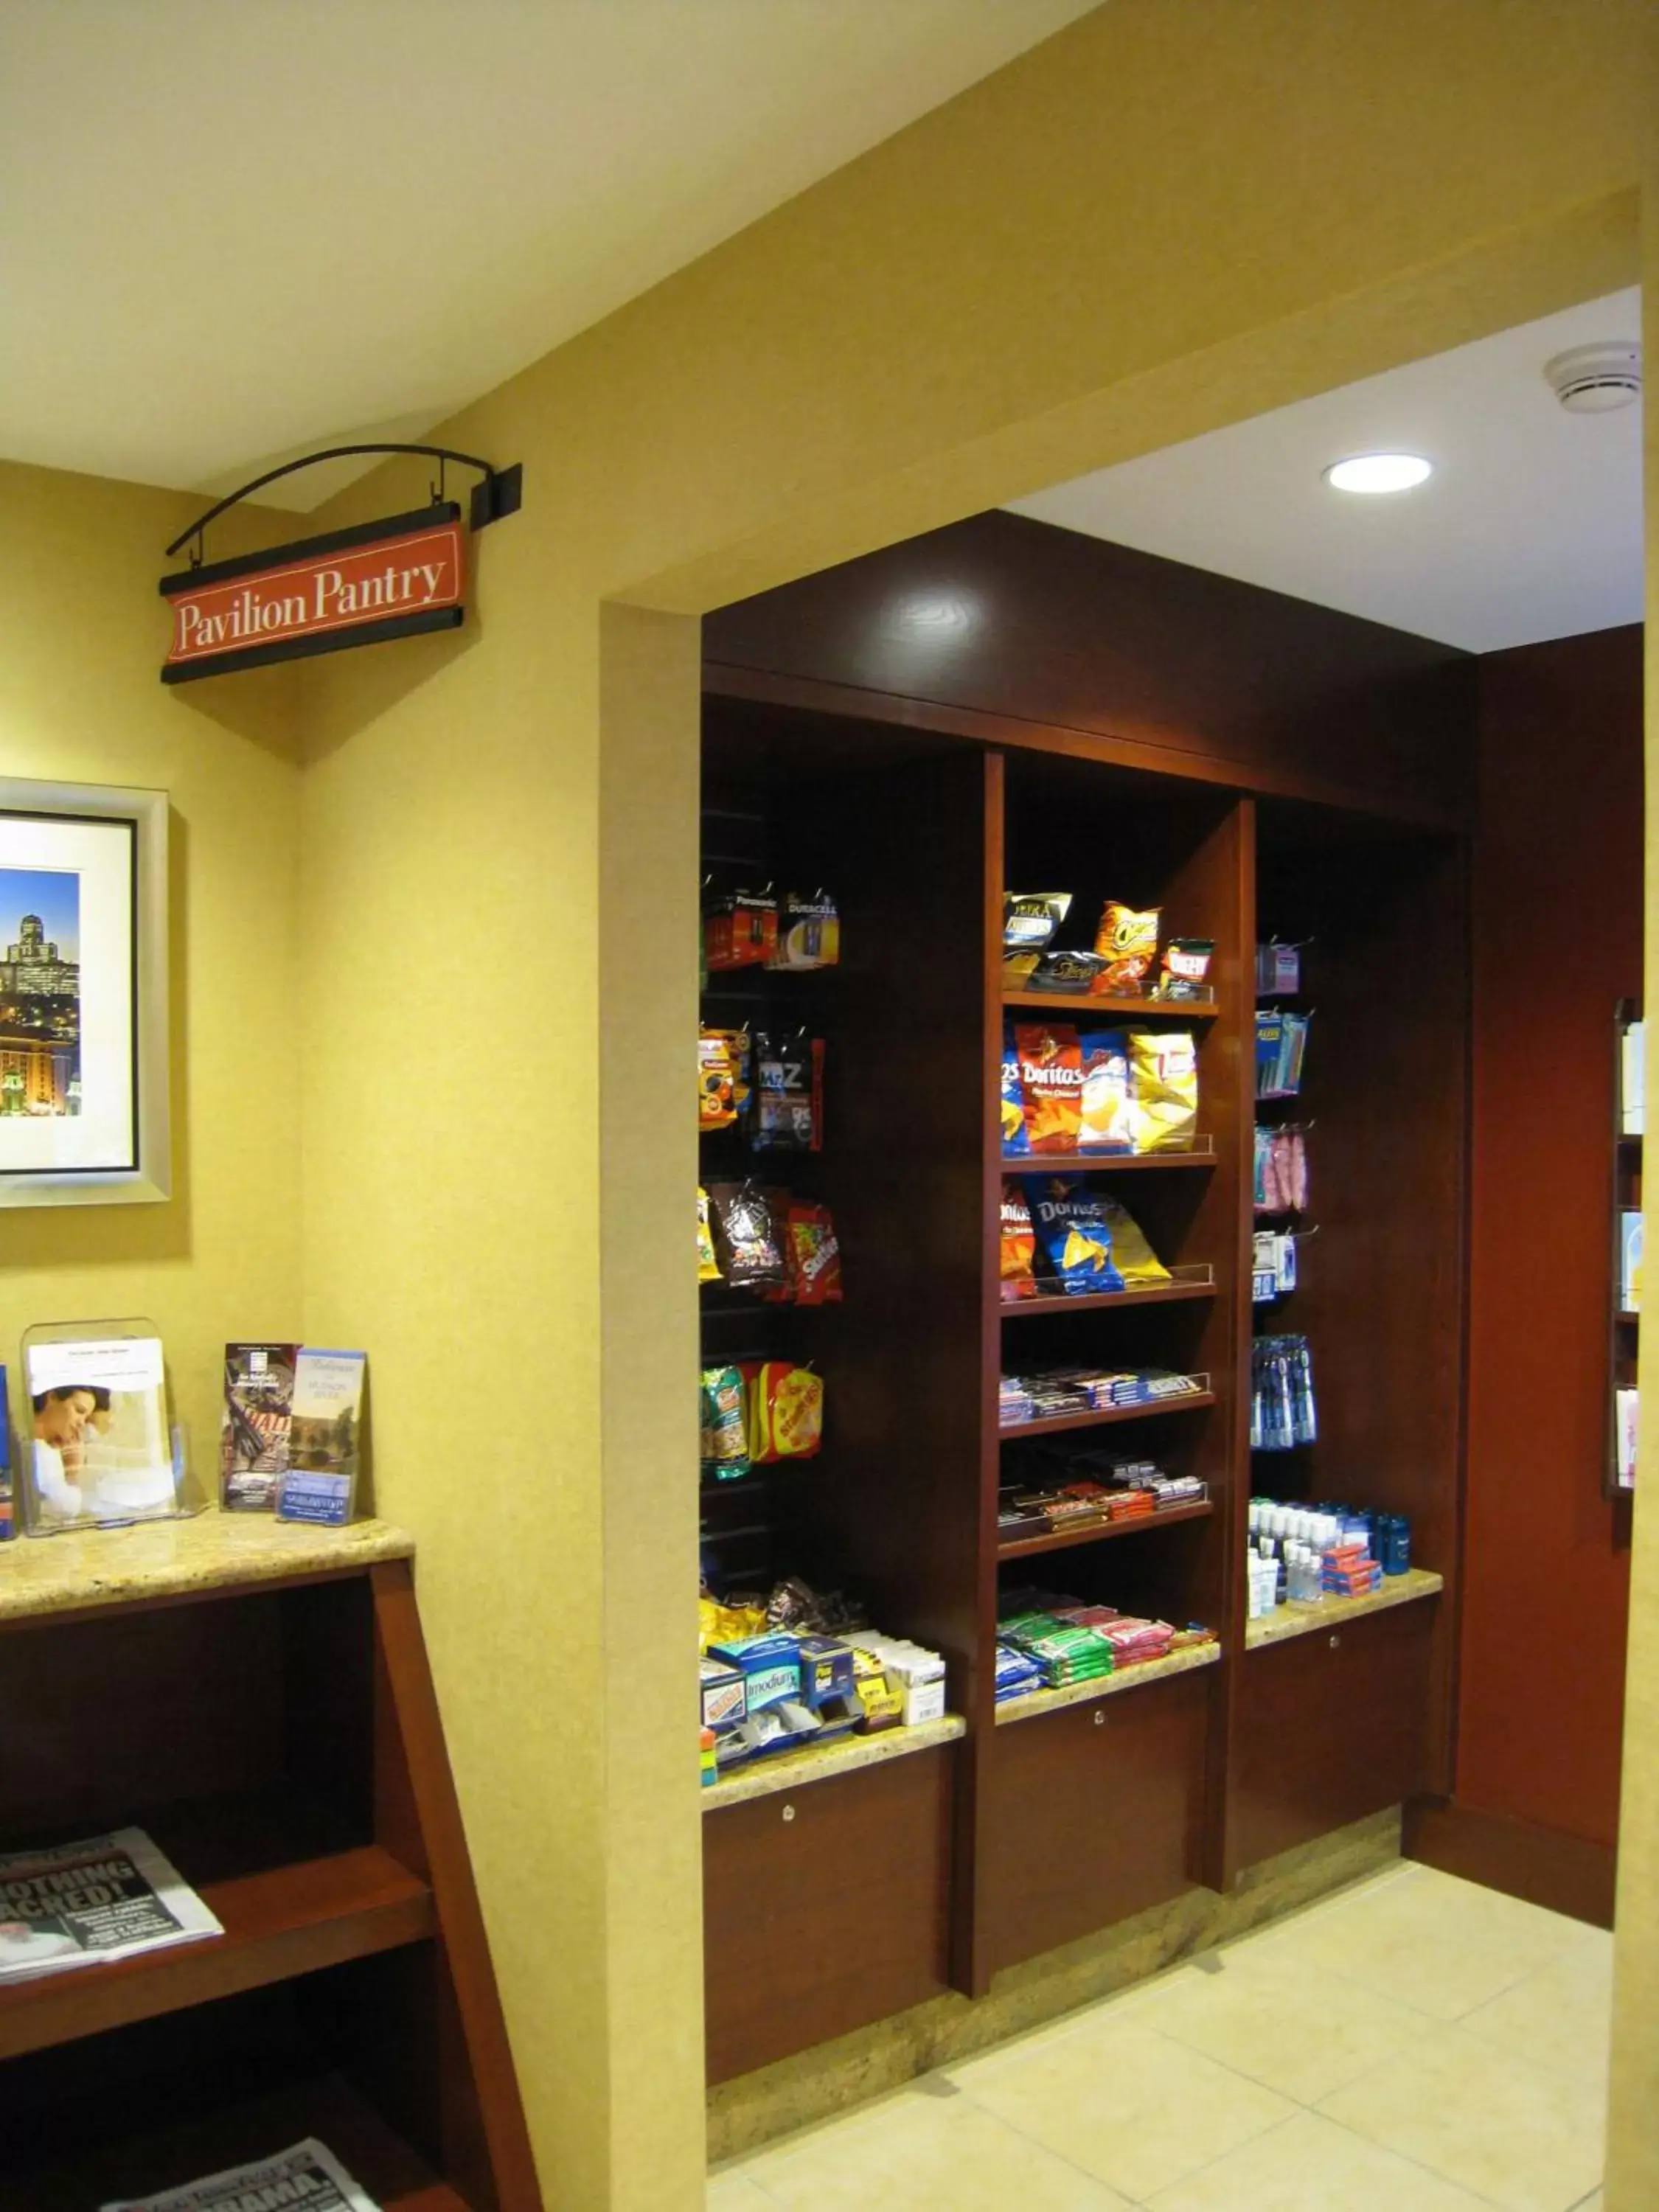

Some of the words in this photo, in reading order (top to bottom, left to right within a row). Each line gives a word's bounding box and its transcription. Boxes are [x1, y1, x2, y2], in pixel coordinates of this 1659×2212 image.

[179, 591, 306, 651] Pavilion
[314, 562, 446, 619] Pantry
[788, 904, 838, 914] DURACELL
[1022, 1061, 1083, 1085] Doritos
[1037, 1201, 1103, 1222] Doritos
